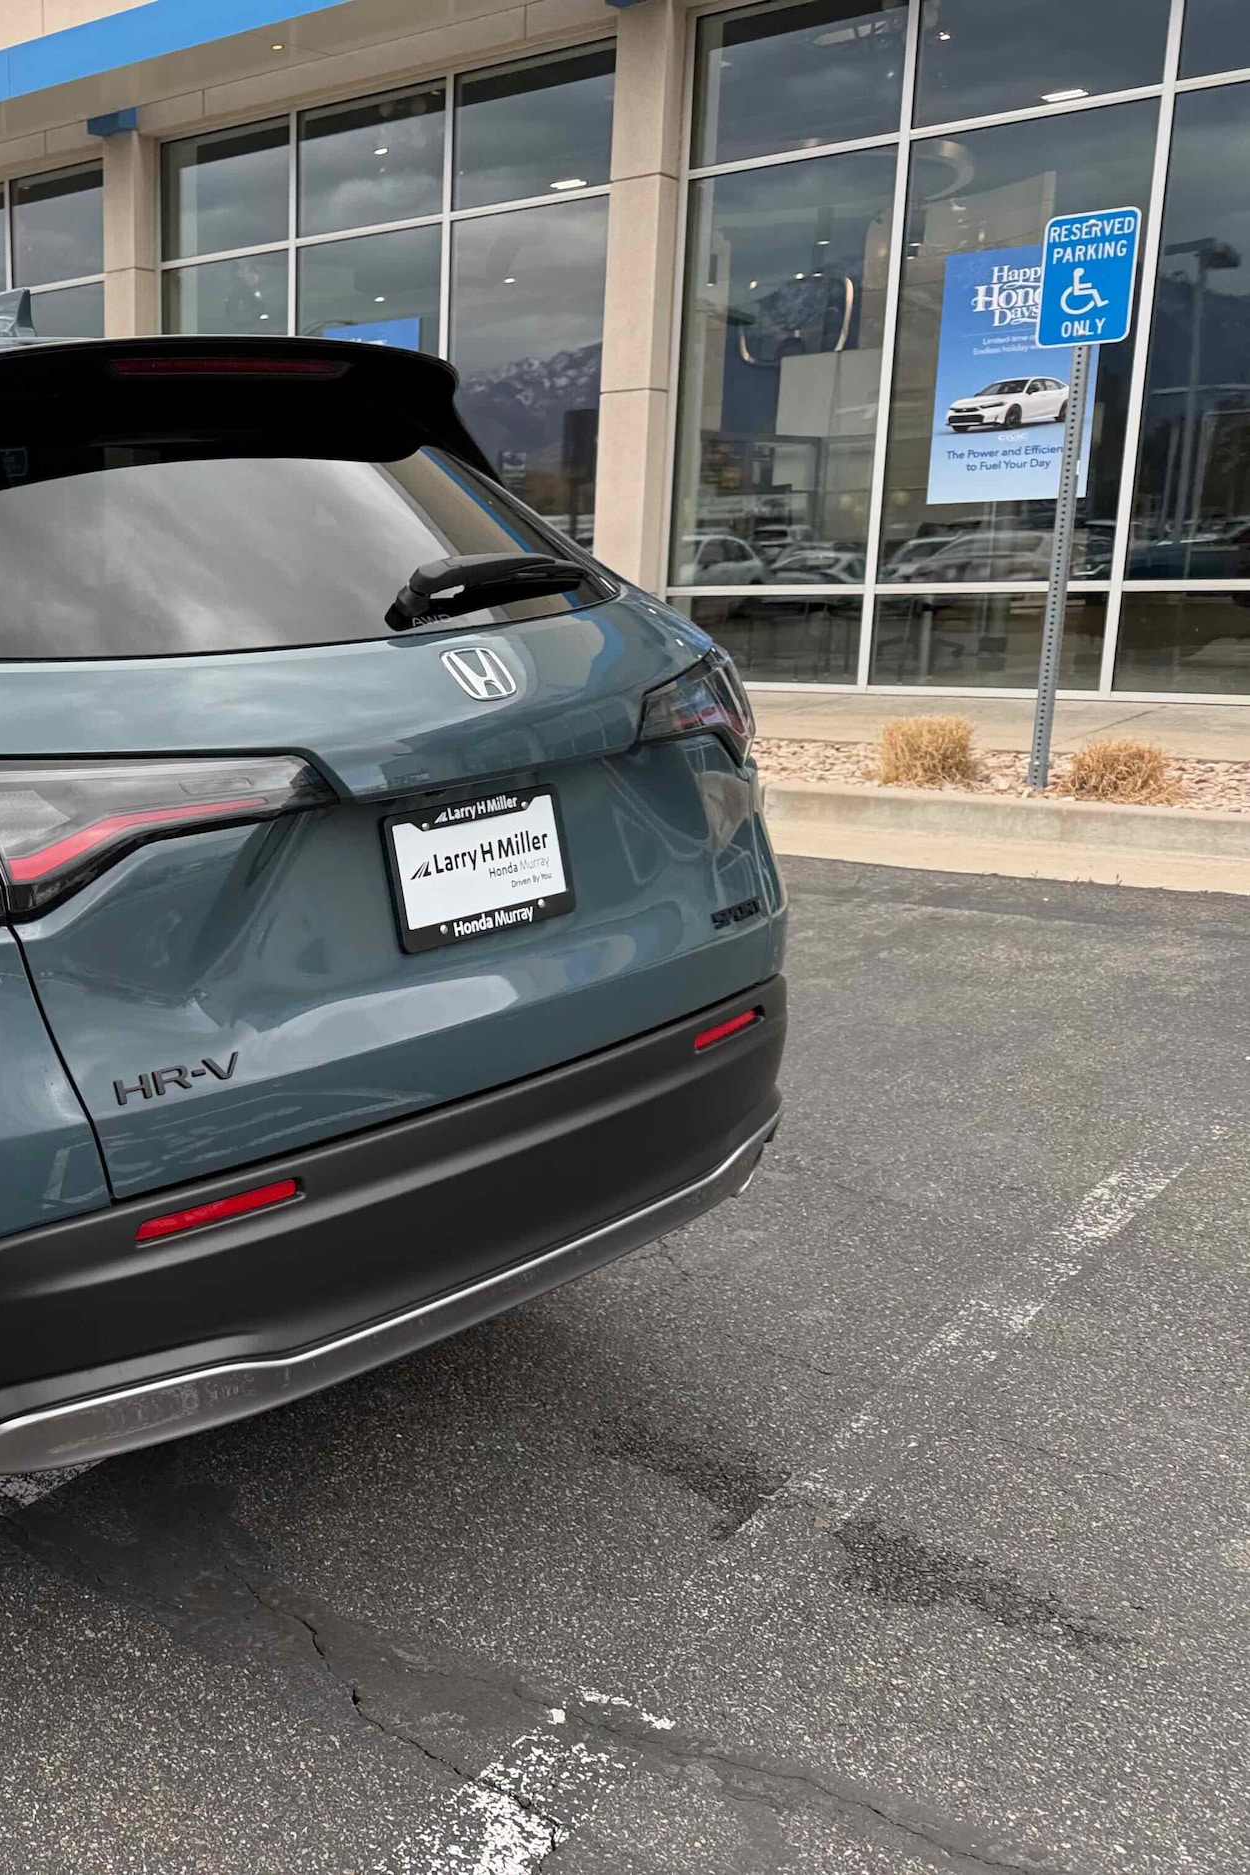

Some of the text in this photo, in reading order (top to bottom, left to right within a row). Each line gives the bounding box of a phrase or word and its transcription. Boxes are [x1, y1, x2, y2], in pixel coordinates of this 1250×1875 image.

[1049, 217, 1135, 243] RESERVED
[1052, 239, 1128, 265] PARKING
[991, 265, 1042, 288] Happ
[971, 283, 1042, 312] Hon
[992, 306, 1039, 327] Days
[1061, 318, 1106, 338] ONLY
[946, 445, 1063, 460] The Power and Efficien
[966, 458, 1051, 471] to Fuel Your Day
[412, 614, 452, 626] AWD
[447, 795, 518, 821] Larry H Miller
[433, 830, 548, 874] Larry H Miller
[488, 856, 550, 878] Honda Murray
[511, 877, 531, 888] Driven
[532, 874, 540, 883] By
[453, 905, 534, 937] Honda Murray
[113, 1051, 239, 1106] HR-V
